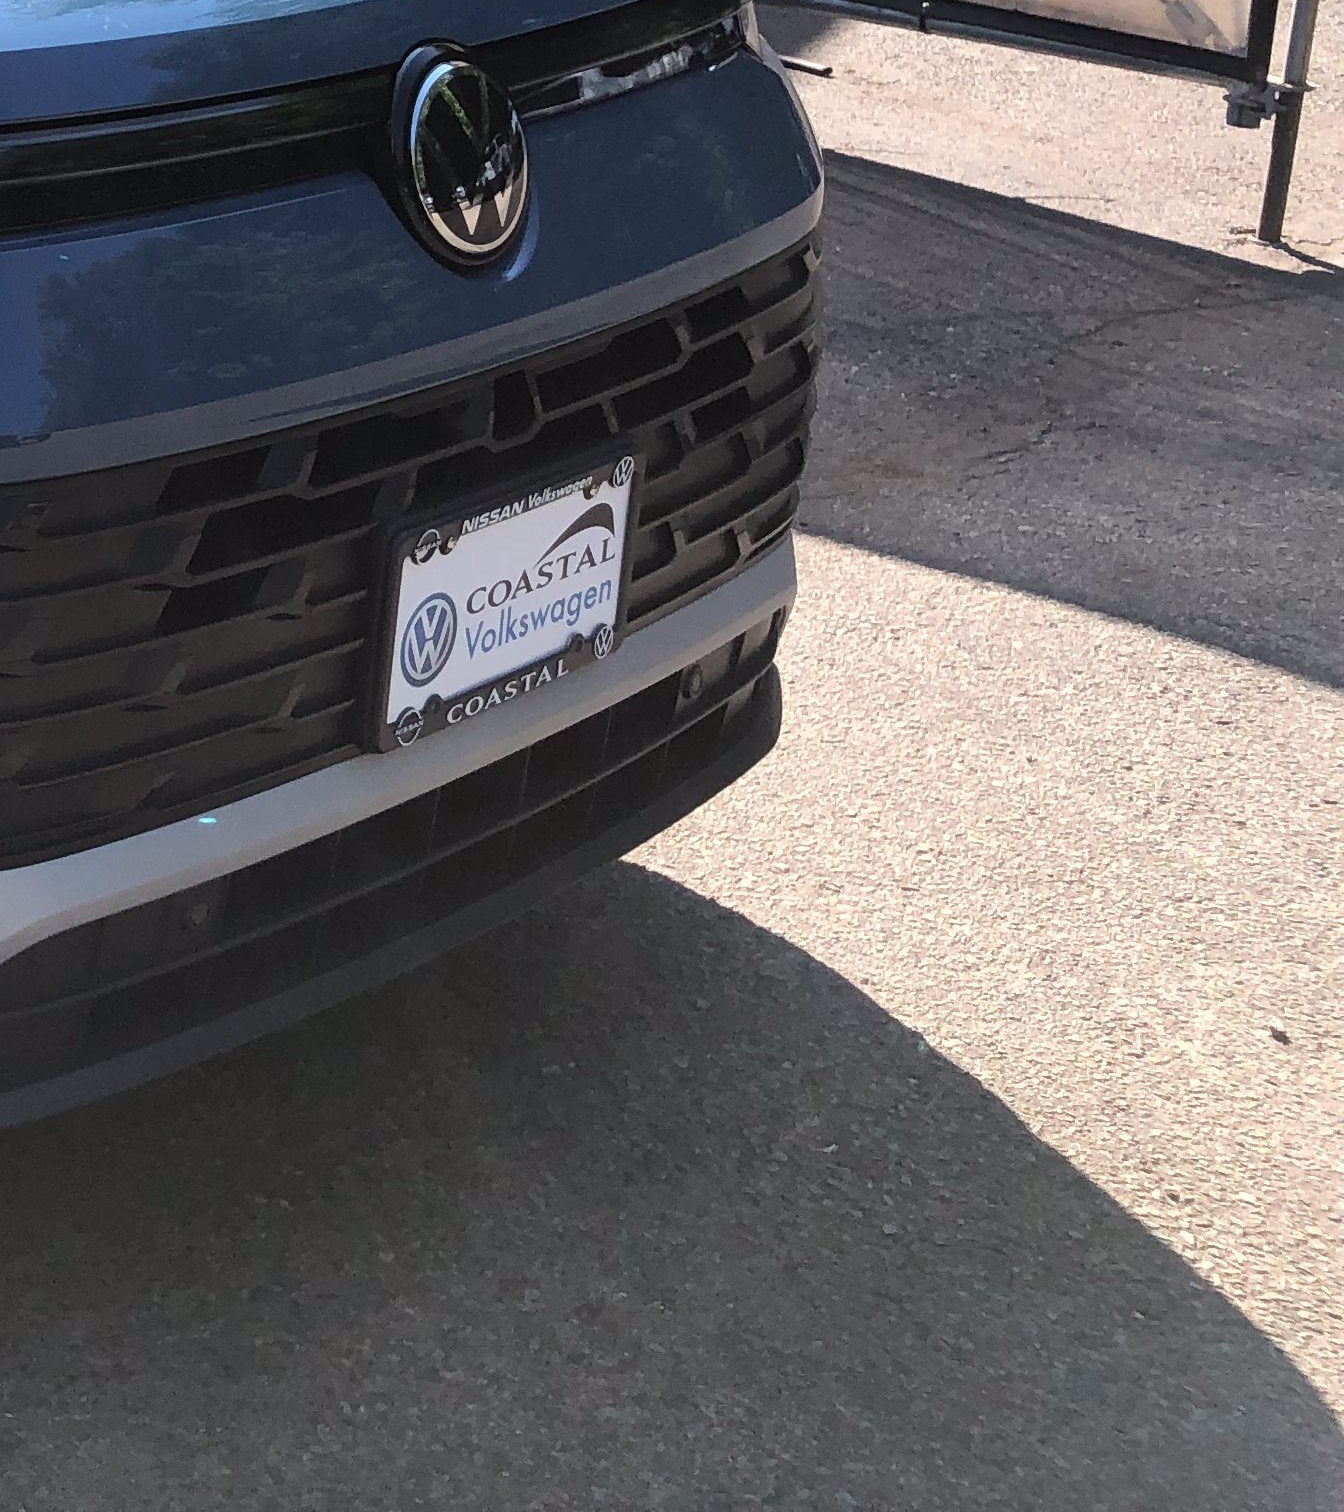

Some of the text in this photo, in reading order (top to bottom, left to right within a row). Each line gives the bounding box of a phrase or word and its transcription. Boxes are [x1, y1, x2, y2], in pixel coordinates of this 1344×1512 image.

[613, 456, 634, 488] VW
[462, 476, 593, 534] NISSAN Volkswagen
[466, 537, 616, 615] COASTAL
[400, 592, 457, 687] VW
[465, 579, 612, 660] Volkswagen
[594, 625, 614, 659] VW
[447, 659, 569, 724] COASTAL
